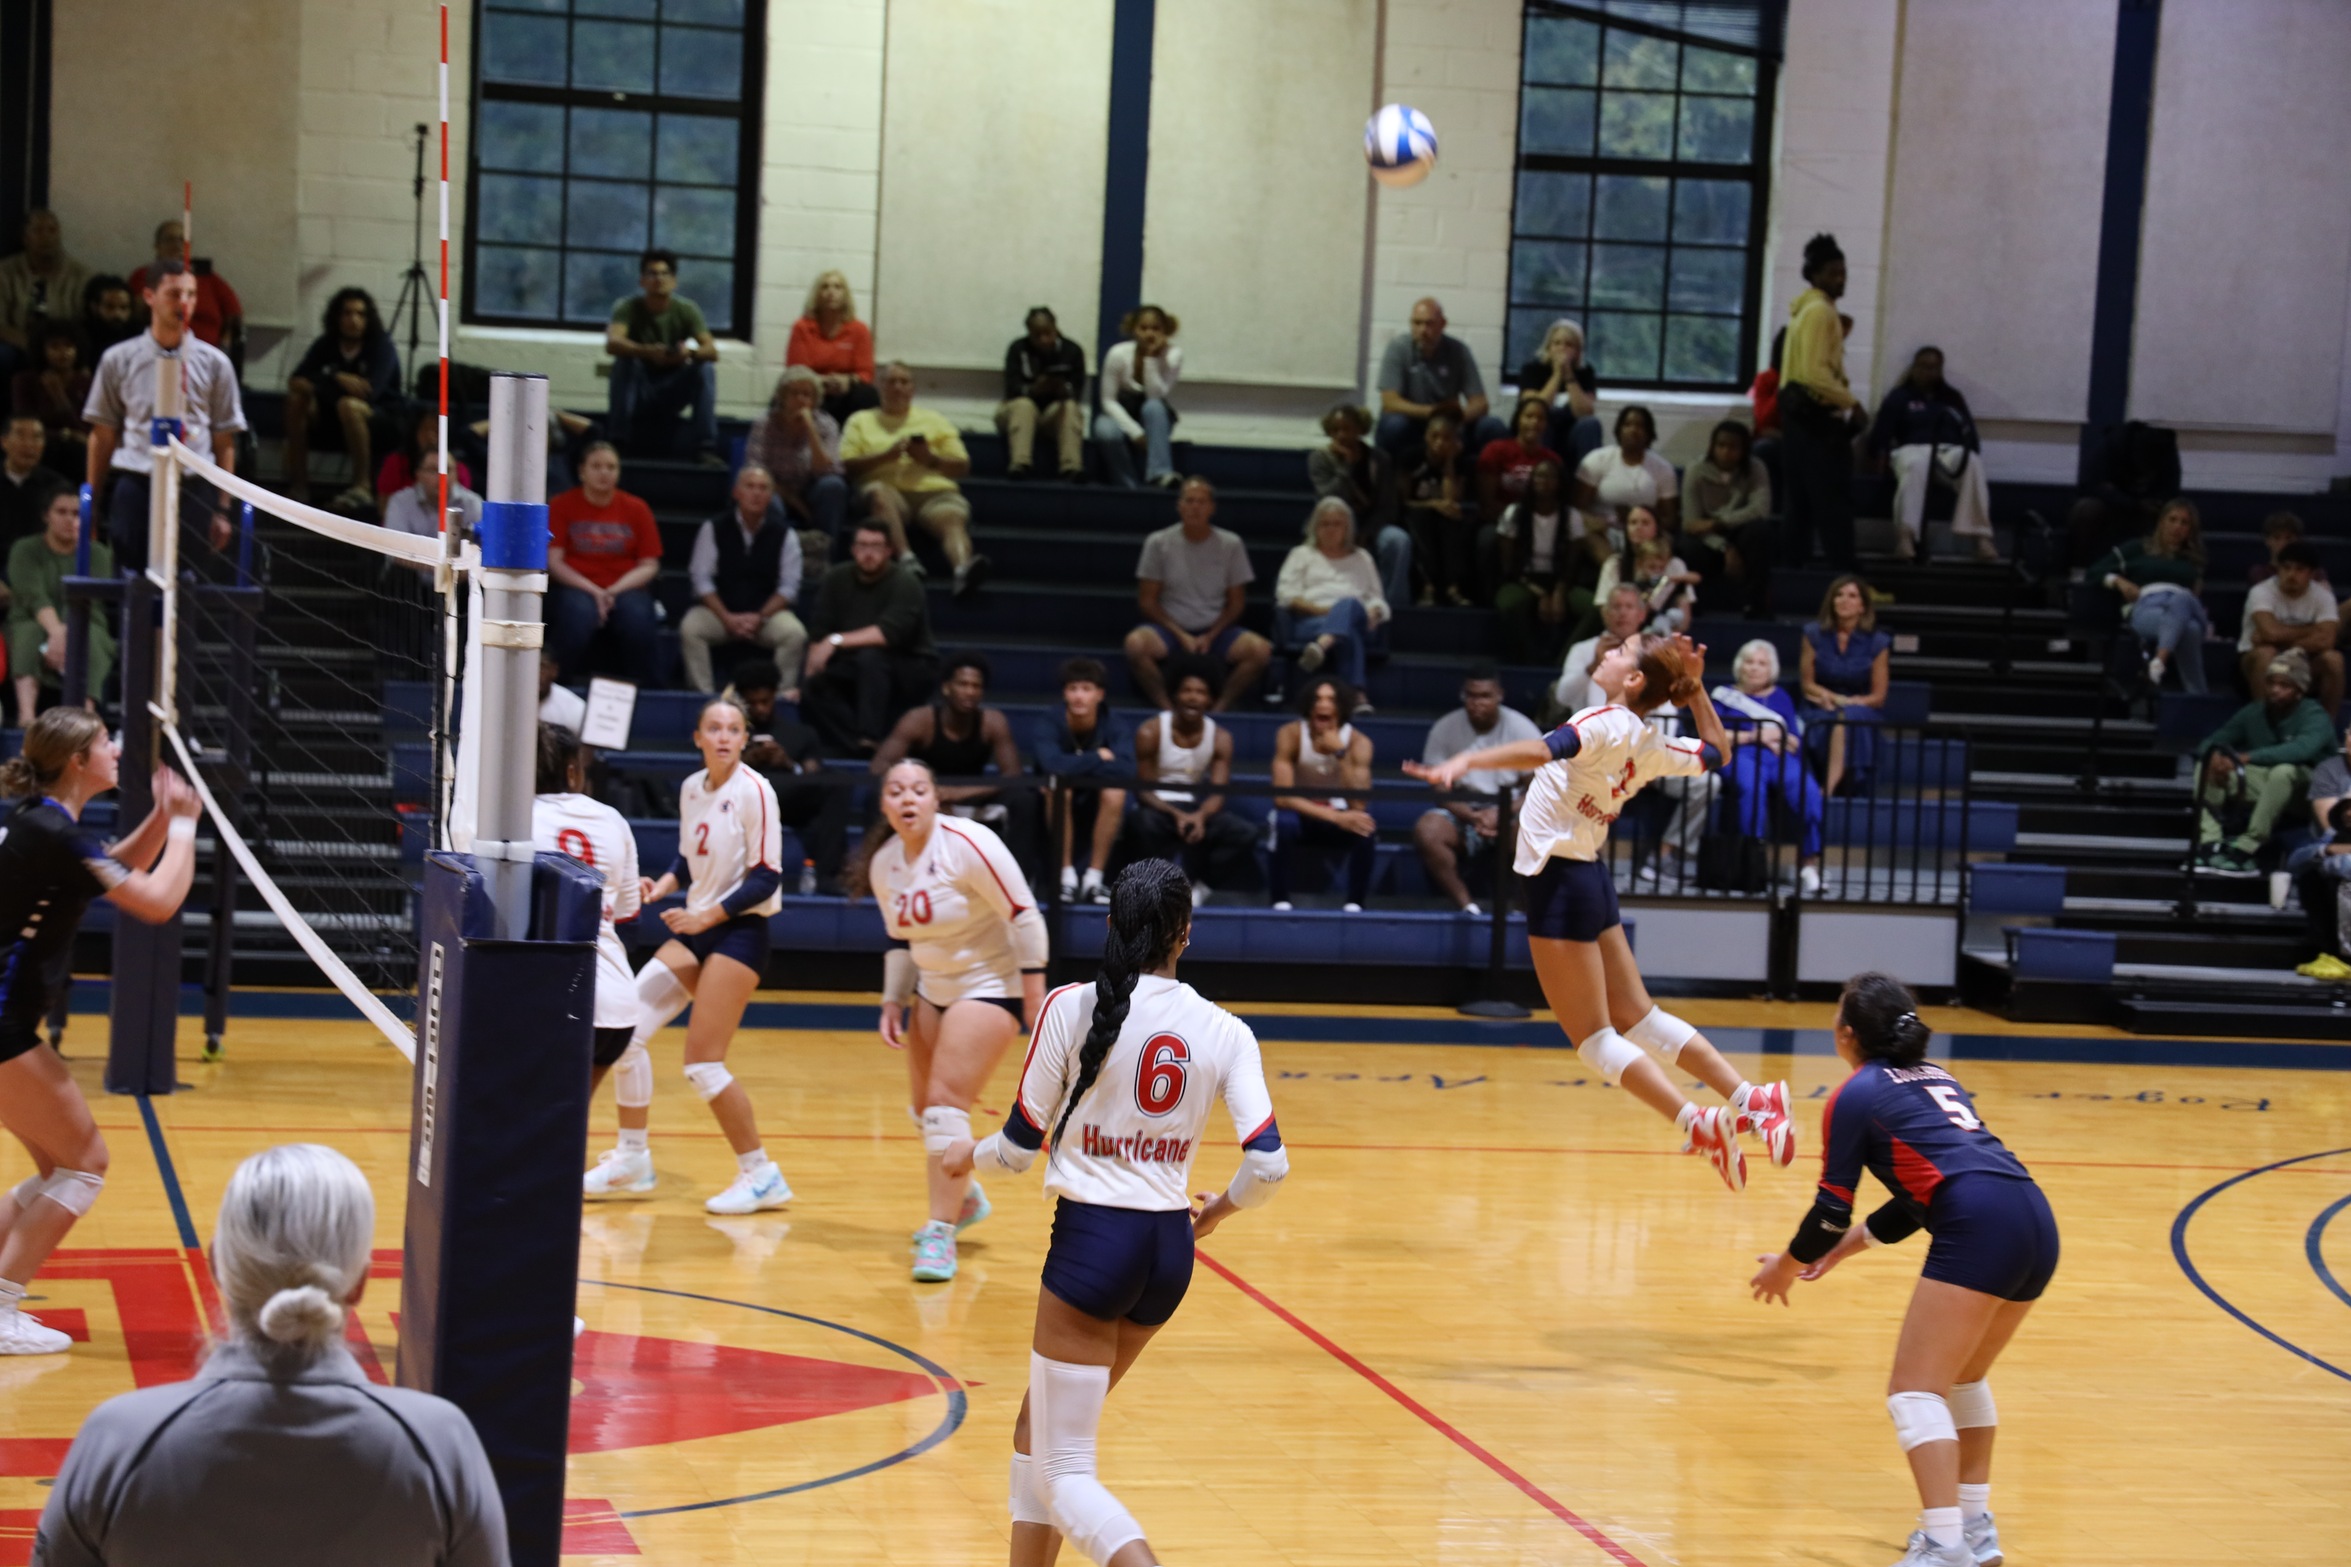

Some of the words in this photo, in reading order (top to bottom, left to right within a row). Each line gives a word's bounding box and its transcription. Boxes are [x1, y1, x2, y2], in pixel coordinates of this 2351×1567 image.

[558, 828, 595, 868] 9
[695, 823, 710, 856] 2
[895, 889, 933, 928] 20
[1134, 1031, 1191, 1118] 6
[1922, 1085, 1981, 1132] 5
[2022, 1089, 2270, 1113] Roger
[1081, 1123, 1195, 1163] Hurricane
